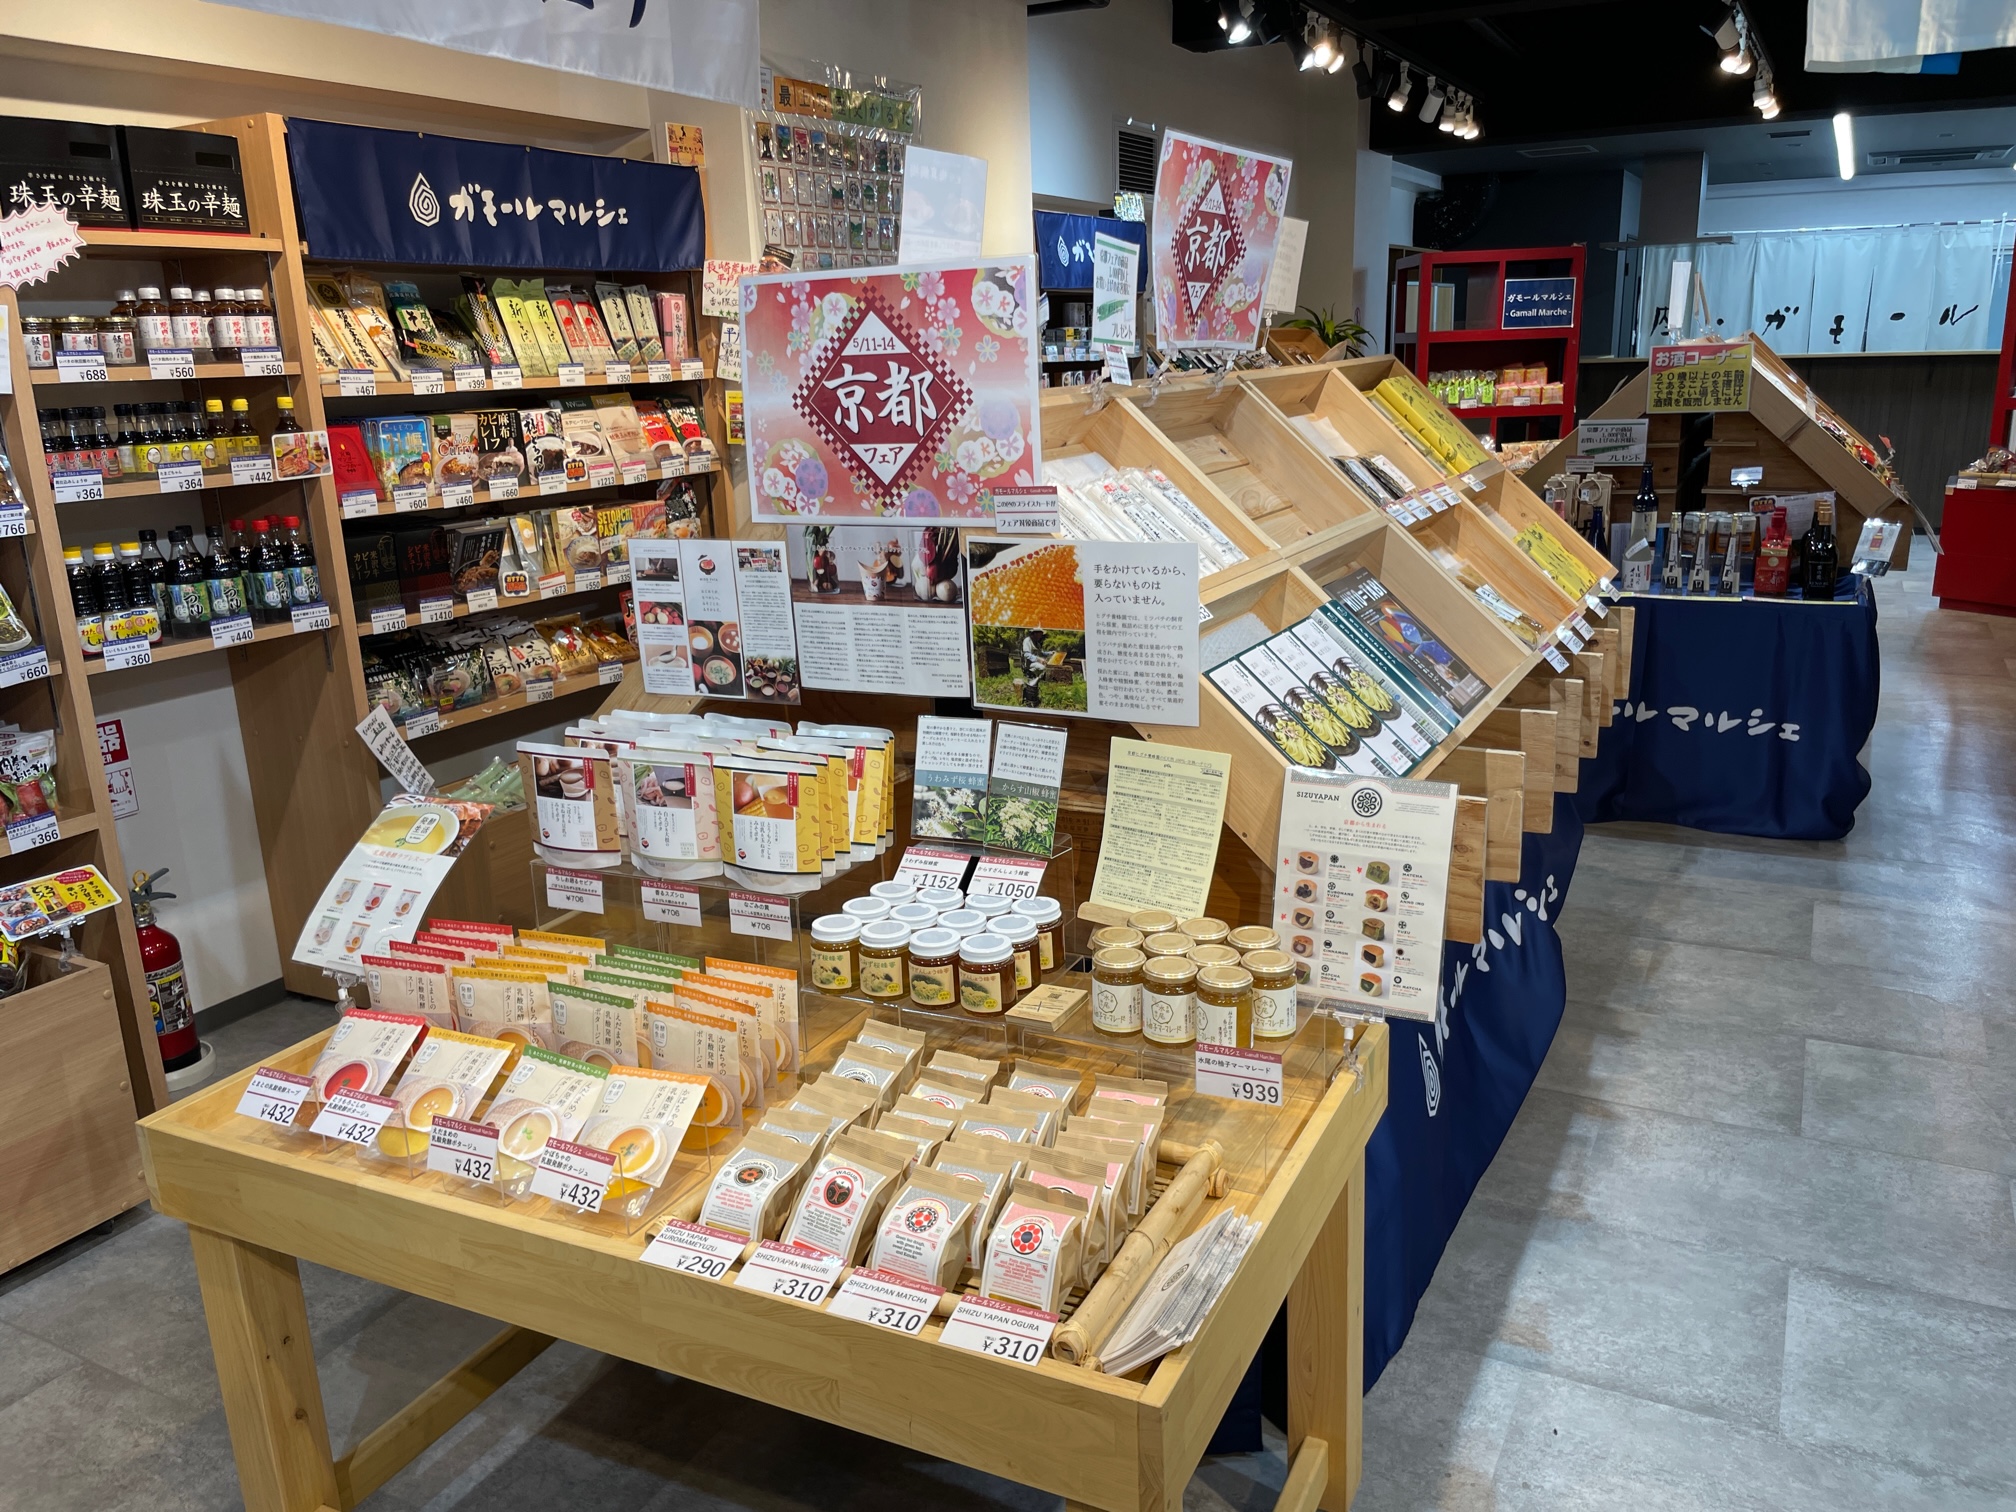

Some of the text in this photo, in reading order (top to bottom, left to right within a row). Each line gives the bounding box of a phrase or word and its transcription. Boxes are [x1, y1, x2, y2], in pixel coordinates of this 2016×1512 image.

[9, 180, 123, 212] 珠玉の辛麺
[142, 188, 243, 219] 珠玉の辛麺
[449, 183, 629, 226] ガモールマルシェ
[1184, 217, 1232, 277] 京都
[1189, 283, 1206, 299] フェア
[1507, 291, 1572, 302] ガモールマルシェ
[1509, 306, 1568, 317] Gamall Marche
[1112, 323, 1133, 340] プレゼント
[852, 336, 896, 353] 5/11-14
[1654, 350, 1748, 367] お酒コーナー
[80, 368, 107, 381] ¥688
[169, 366, 194, 378] ¥560
[261, 363, 283, 375] ¥560
[658, 373, 672, 382] ¥390
[691, 370, 704, 379] ¥658
[468, 379, 485, 389] ¥399
[617, 374, 631, 383] ¥350
[356, 386, 375, 395] ¥467
[426, 384, 443, 393] ¥277
[822, 361, 937, 437] 京都
[1653, 397, 1743, 408] 酒類を販売しません
[479, 414, 491, 451] カレー
[488, 413, 501, 450] ビーフ
[498, 413, 510, 439] 麻布
[863, 446, 904, 467] フェア
[1608, 454, 1641, 462] プレゼント
[671, 468, 685, 476] ¥712
[697, 463, 710, 471] ¥766
[178, 478, 203, 490] ¥364
[250, 471, 273, 482] ¥442
[597, 477, 615, 486] ¥1213
[76, 487, 103, 500] ¥364
[455, 495, 473, 505] ¥460
[502, 488, 518, 497] ¥660
[409, 499, 428, 509] ¥604
[1093, 564, 1187, 577] 手をかけているから、
[551, 585, 567, 595] ¥673
[585, 581, 600, 590] ¥550
[1093, 579, 1161, 590] 要らないものは
[1094, 594, 1165, 607] 入っていません。
[309, 617, 330, 630] ¥440
[430, 611, 453, 621] ¥1410
[382, 619, 406, 632] ¥1410
[230, 629, 253, 643] ¥440
[124, 653, 151, 666] ¥360
[19, 664, 48, 681] ¥660
[609, 673, 623, 682] ¥308
[537, 691, 553, 699] ¥308
[420, 723, 439, 734] ¥345
[12, 762, 48, 783] おにぎり
[927, 774, 985, 787] うわみず桜 蜂蜜
[1002, 782, 1058, 800] からす山椒 蜂蜜
[1296, 791, 1340, 802] SIZUYAPAN
[30, 829, 59, 846] ¥366
[912, 873, 958, 891] ¥1152
[987, 882, 1035, 899] ¥1050
[565, 894, 585, 904] ¥706
[654, 889, 685, 899] 香るスズシロ
[661, 908, 681, 917] ¥706
[751, 921, 771, 931] ¥706
[407, 974, 415, 995] スープ
[417, 975, 426, 1009] 乳酸発酵
[428, 977, 437, 1010] とまとの
[504, 986, 513, 1024] ポタージュ
[516, 986, 525, 1021] 乳酸発酵
[777, 983, 786, 1024] かぼちゃの
[528, 987, 539, 1045] とうもろこしの
[593, 1008, 602, 1047] ポタージュ
[604, 1010, 612, 1046] 乳酸発酵
[614, 1013, 623, 1055] えだまめの
[740, 1019, 749, 1058] かぼちゃの
[706, 1033, 715, 1069] 乳酸発酵
[718, 1035, 727, 1076] かぼちゃの
[1198, 1043, 1240, 1057] ガモールマルシェ
[257, 1067, 287, 1080] ガモールマルシェ
[1197, 1056, 1271, 1074] 水尾の柚子マーマレード
[251, 1078, 301, 1096] とまとの乳酸発酵スープ
[338, 1088, 369, 1101] ガモールマルシェ
[543, 1074, 573, 1104] ポタージュ
[1231, 1081, 1279, 1104] ¥939
[332, 1095, 366, 1109] とうもろこしの
[564, 1079, 594, 1120] えだまめの
[644, 1084, 667, 1120] ポタージュ
[666, 1089, 689, 1127] かぼちゃの
[261, 1103, 296, 1124] ¥432
[327, 1103, 370, 1119] 乳酸発酵ポタージュ
[433, 1116, 467, 1129] ガモールマルシェ
[337, 1123, 376, 1144] ¥432
[432, 1127, 458, 1139] えだまめの
[431, 1134, 477, 1151] 乳酸発酵ポタージュ
[547, 1138, 582, 1156] ガモールマルシェ
[543, 1148, 571, 1162] かぼちゃの
[455, 1158, 491, 1181] ¥432
[541, 1157, 589, 1176] 乳酸発酵ポタージュ
[835, 1169, 858, 1183] WAGURI
[560, 1183, 600, 1209] ¥432
[664, 1227, 710, 1243] SHIZU YAPAN
[670, 1219, 710, 1236] ガモールマルシェ
[659, 1233, 718, 1253] KUROMAMEYUZU
[763, 1239, 806, 1257] ガモールマルシェ
[676, 1256, 726, 1278] ¥290
[755, 1252, 829, 1275] SHIZUYAPAN WAGURI
[856, 1267, 901, 1285] ガモールマルシェ
[773, 1279, 824, 1302] ¥310
[848, 1279, 928, 1305] SHIZUYAPAN MATCHA
[963, 1294, 1013, 1313] ガモールマルシェ
[868, 1308, 921, 1332] ¥310
[957, 1306, 1040, 1333] SHIZU YAPAN OGURA
[982, 1336, 1039, 1363] ¥310
